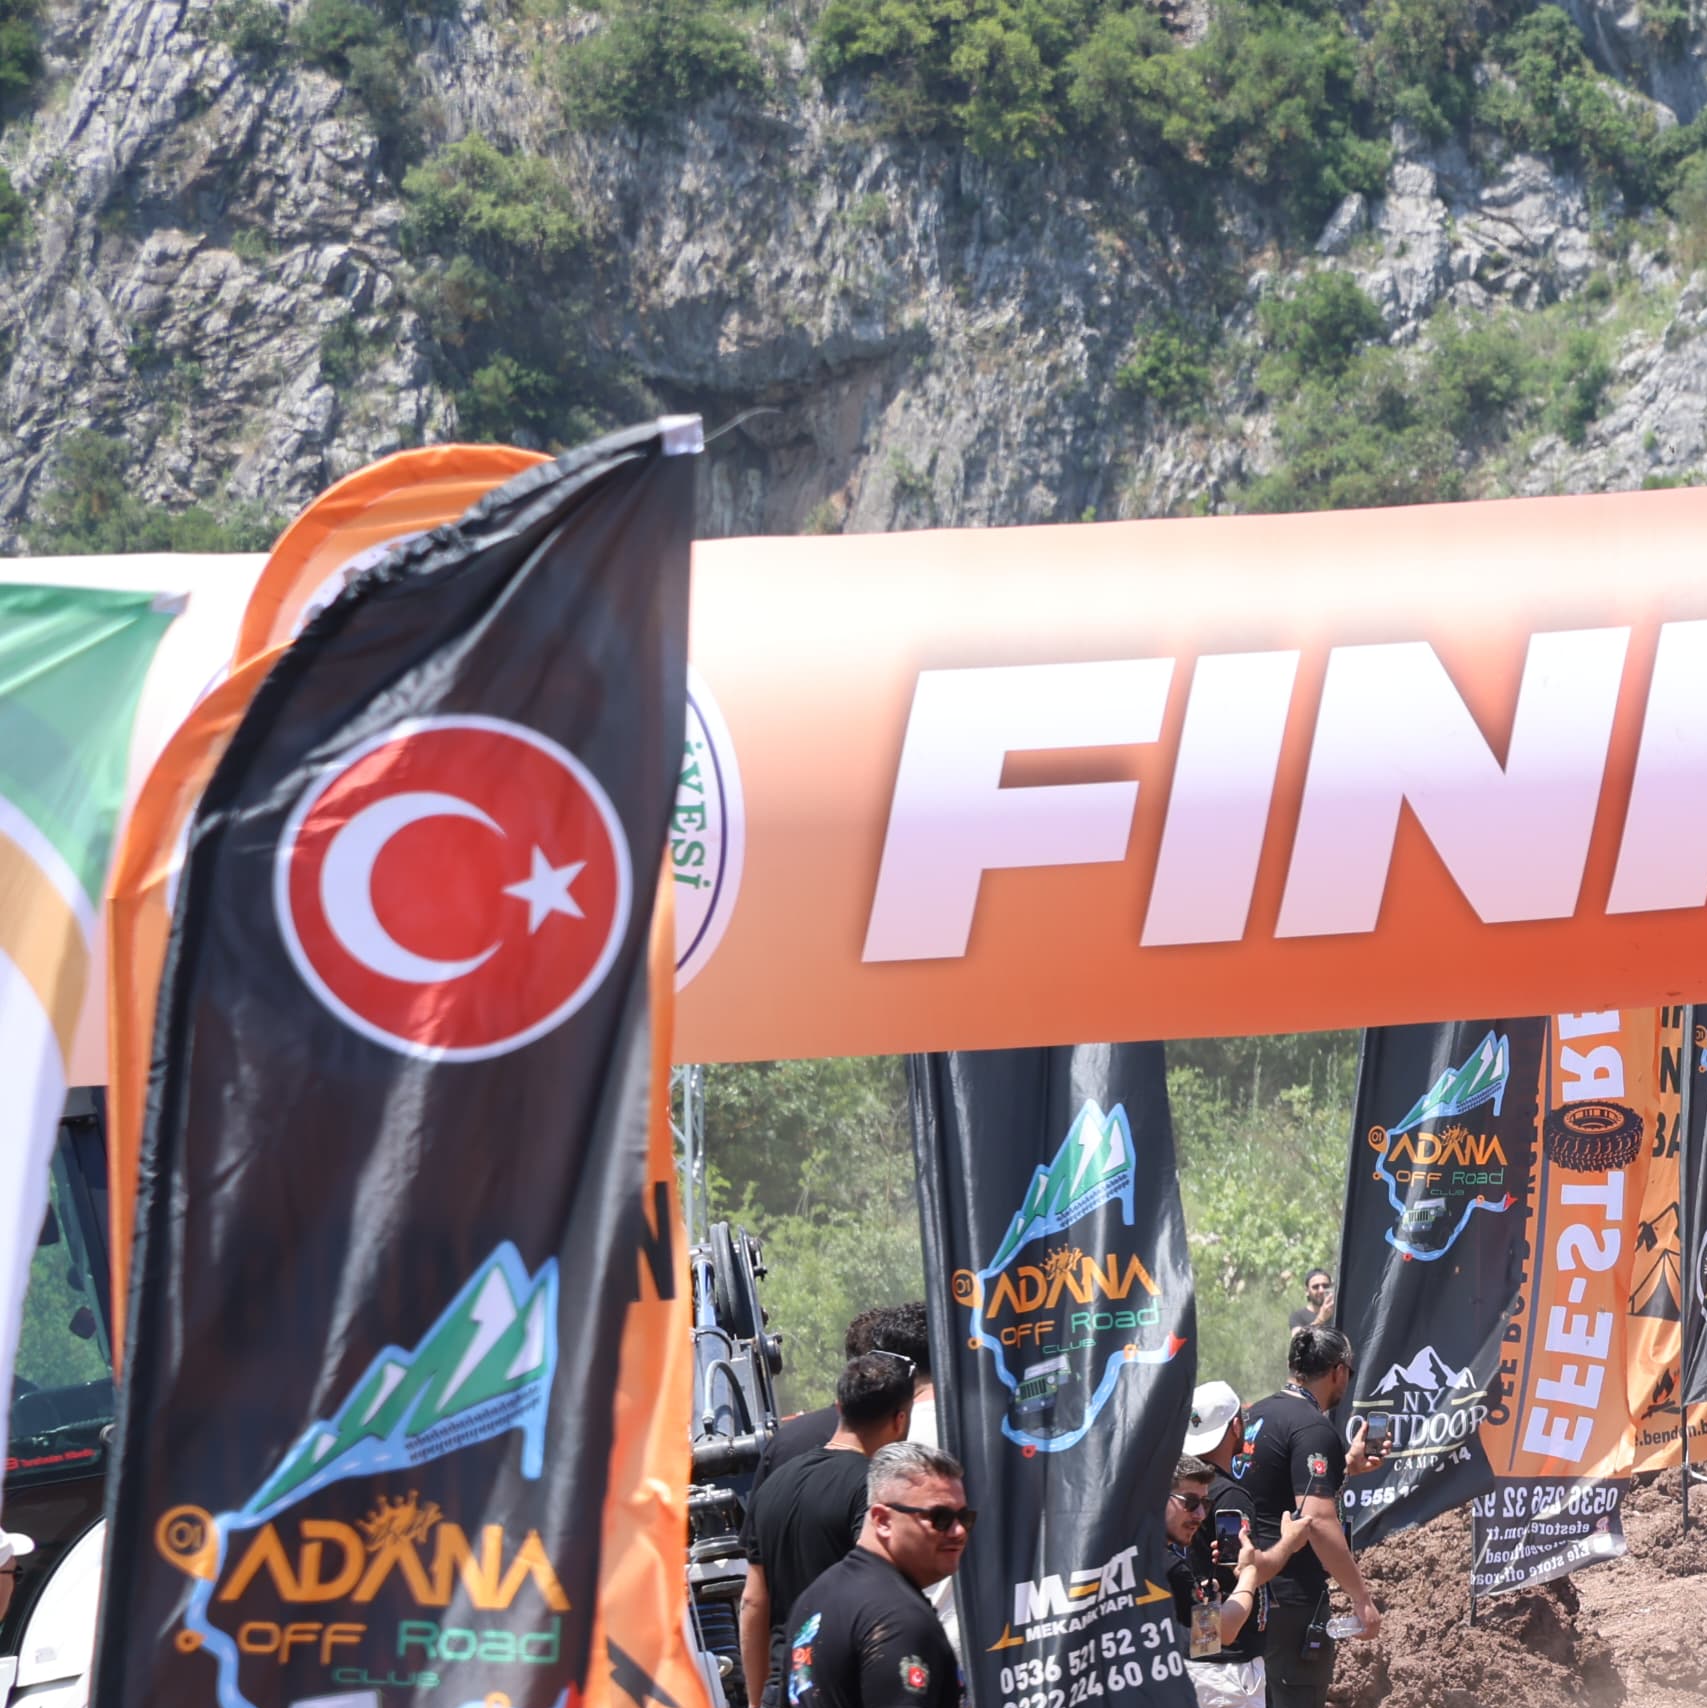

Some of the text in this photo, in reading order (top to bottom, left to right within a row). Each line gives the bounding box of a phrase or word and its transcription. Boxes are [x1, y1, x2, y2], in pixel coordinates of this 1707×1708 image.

[1387, 1131, 1509, 1166] ADANA
[1395, 1169, 1443, 1189] OFF
[955, 1252, 1162, 1319] 01 ADANA
[1001, 1320, 1055, 1348] OFF
[1042, 1337, 1097, 1355] CLUB
[1402, 1387, 1446, 1414] NY
[1345, 1404, 1488, 1448] OTDOOR
[1343, 1490, 1356, 1508] 0
[1360, 1486, 1397, 1507] 555
[218, 1518, 572, 1611] ADANA
[1014, 1545, 1139, 1626] MERT
[1099, 1593, 1135, 1617] YAPI
[237, 1620, 368, 1666] OFF
[1000, 1654, 1062, 1695] 0536
[1068, 1639, 1096, 1677] 521
[1101, 1628, 1136, 1660] 52
[1140, 1617, 1176, 1650] 31
[331, 1666, 441, 1688] CLUB
[1068, 1670, 1105, 1708] 224
[1107, 1661, 1144, 1692] 60
[1151, 1650, 1184, 1682] 60
